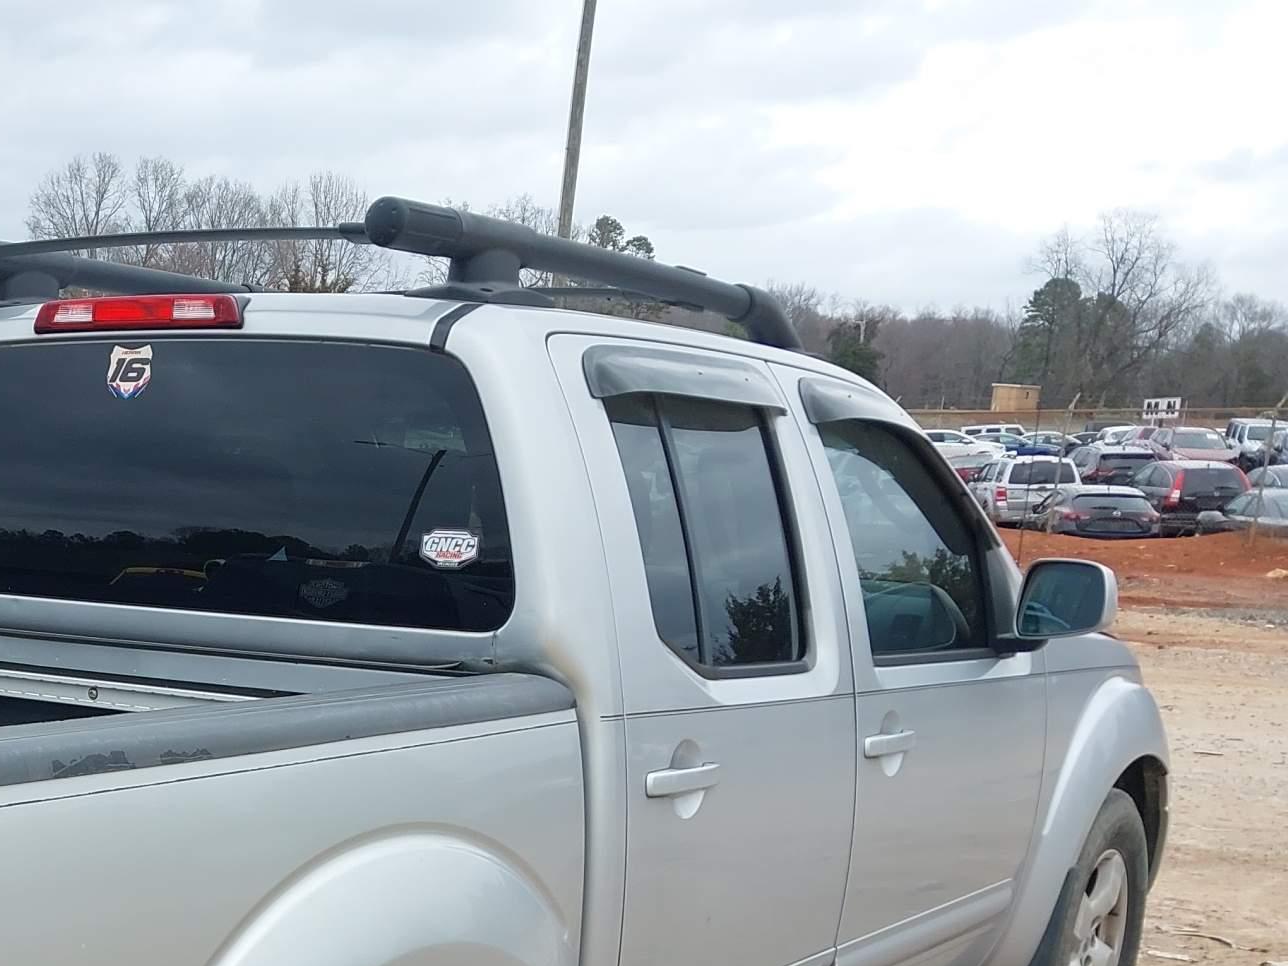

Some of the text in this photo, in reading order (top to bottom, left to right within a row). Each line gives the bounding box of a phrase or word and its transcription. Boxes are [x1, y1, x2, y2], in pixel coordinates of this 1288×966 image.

[109, 358, 151, 382] 16
[425, 537, 475, 553] GNCC
[435, 551, 463, 560] RACING
